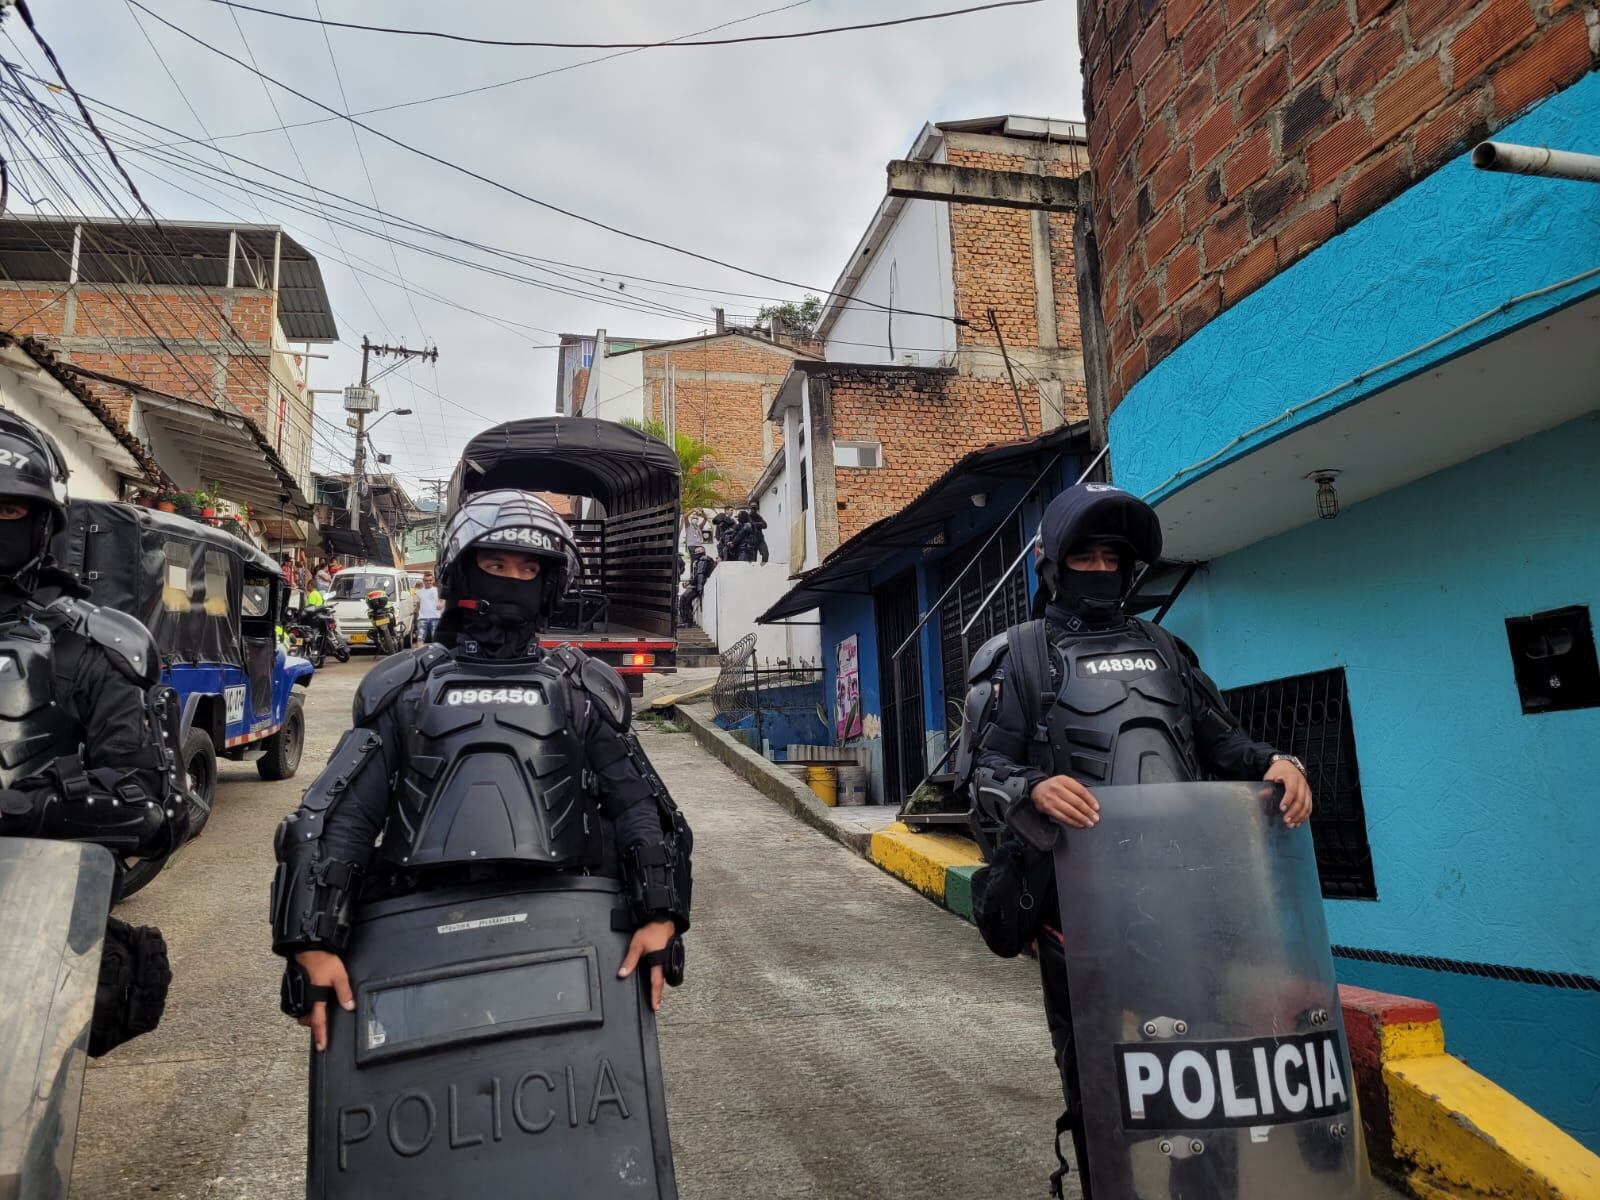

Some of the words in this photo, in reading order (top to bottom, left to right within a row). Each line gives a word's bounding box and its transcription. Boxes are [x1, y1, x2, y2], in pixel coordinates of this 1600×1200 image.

[1086, 658, 1157, 674] 148940
[448, 689, 538, 705] 096450
[1123, 1039, 1347, 1120] POLICIA
[338, 1058, 631, 1172] POLICIA
